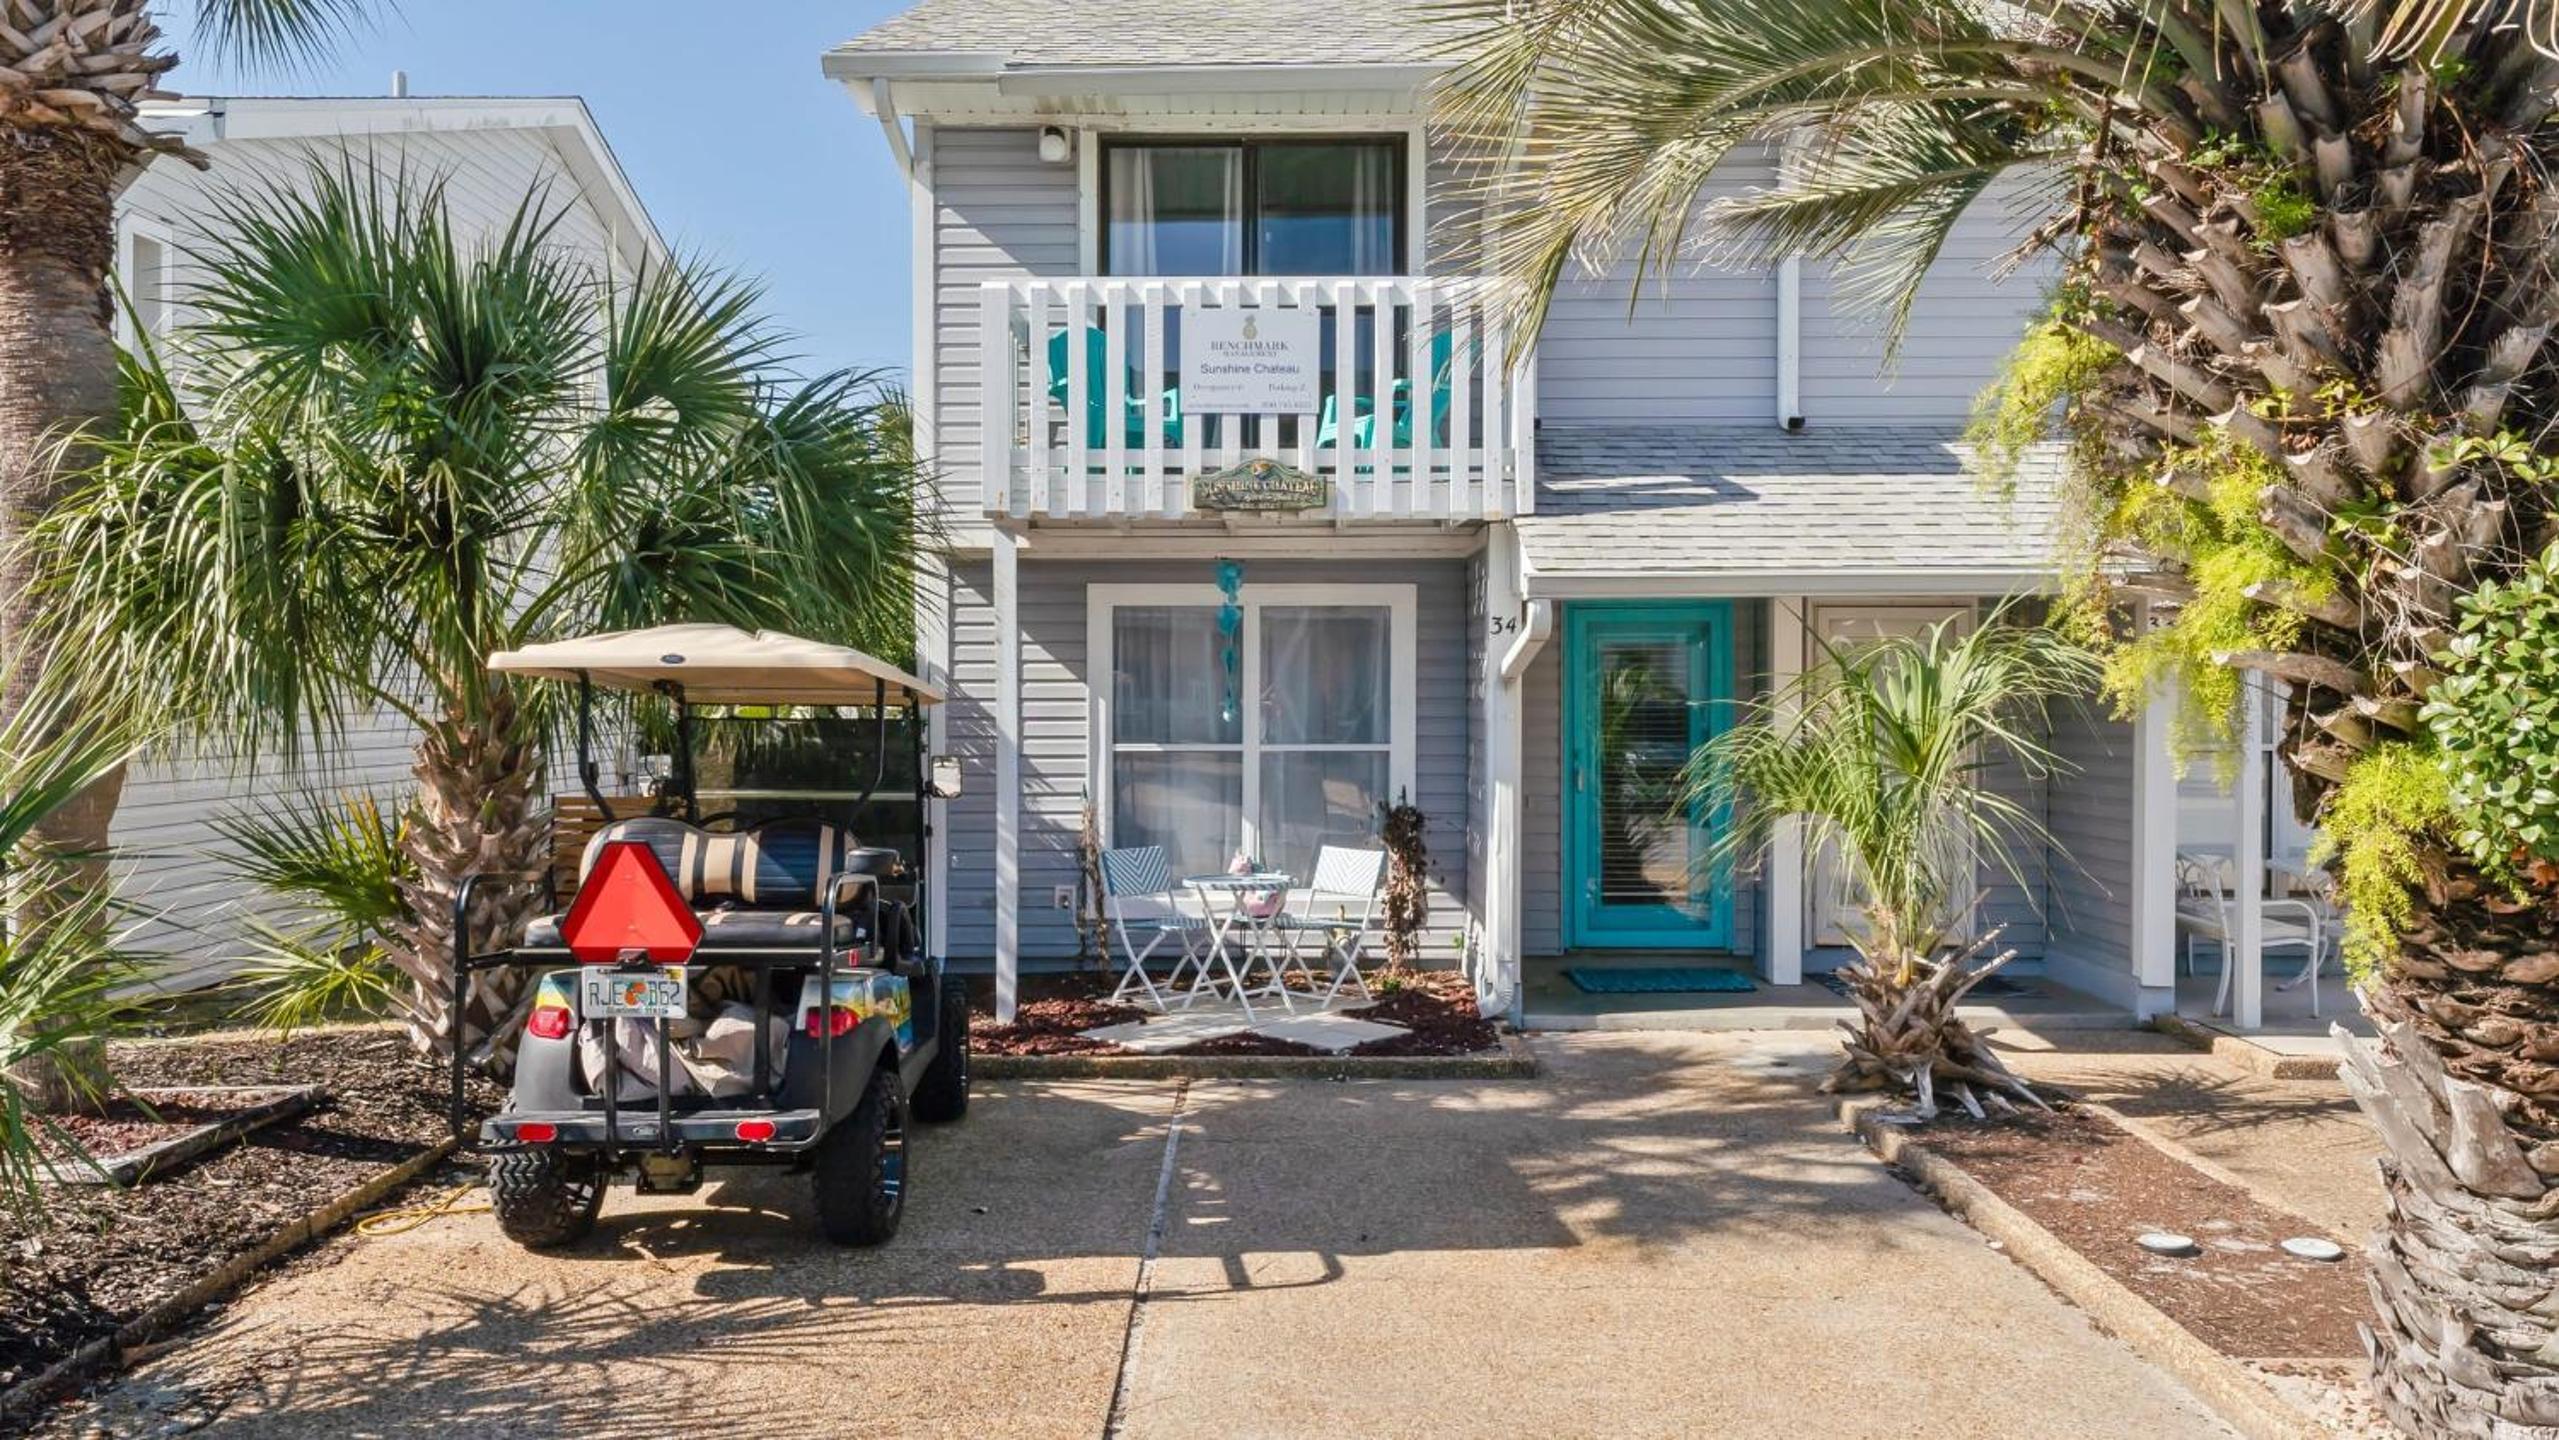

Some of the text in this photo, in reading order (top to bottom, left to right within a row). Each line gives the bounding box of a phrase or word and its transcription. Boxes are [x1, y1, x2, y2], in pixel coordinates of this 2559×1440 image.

[1210, 341, 1289, 351] BENCHMARK
[1200, 363, 1300, 374] Sunshine Chateau
[1490, 616, 1517, 635] 34
[588, 982, 623, 1006] RJE
